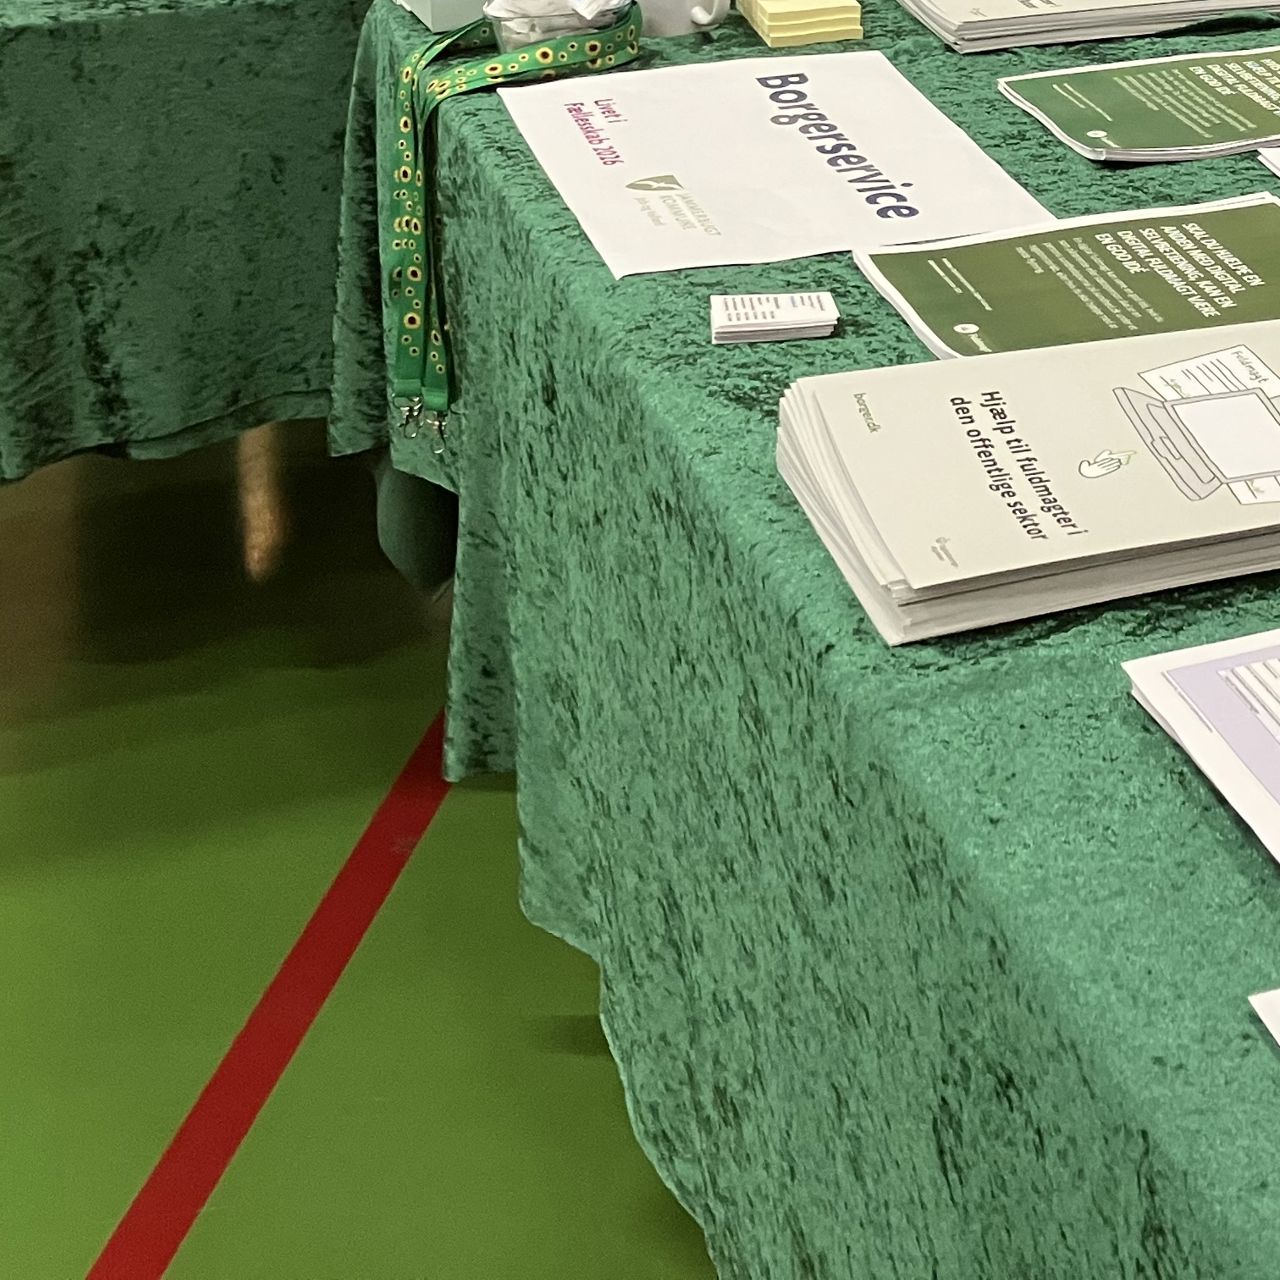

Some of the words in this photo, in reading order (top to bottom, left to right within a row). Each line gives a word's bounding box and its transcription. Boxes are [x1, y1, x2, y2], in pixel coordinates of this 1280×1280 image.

[564, 102, 610, 144] Fællesskab
[594, 99, 619, 118] Livet
[755, 73, 919, 218] Borgerservice
[1095, 233, 1116, 244] EN
[1106, 244, 1132, 261] GOD
[1160, 226, 1197, 250] ANDEN
[1186, 249, 1215, 266] MED
[1209, 265, 1246, 294] DIGITAL
[1182, 223, 1209, 239] SKAL
[1242, 274, 1265, 286] EN
[1117, 231, 1153, 258] DIGITAL
[1150, 258, 1196, 295] FULDMAGT
[1187, 295, 1221, 317] VÆRE
[1195, 280, 1225, 296] KAN
[1213, 296, 1237, 308] EN
[1232, 351, 1269, 383] Fuldmagt
[853, 392, 880, 433] borger.dk
[980, 391, 1016, 434] Hjælp
[1006, 438, 1031, 453] til
[950, 397, 975, 424] den
[967, 429, 1016, 498] offentlige
[1007, 501, 1047, 539] sektor
[1016, 457, 1077, 528] fuldmagter
